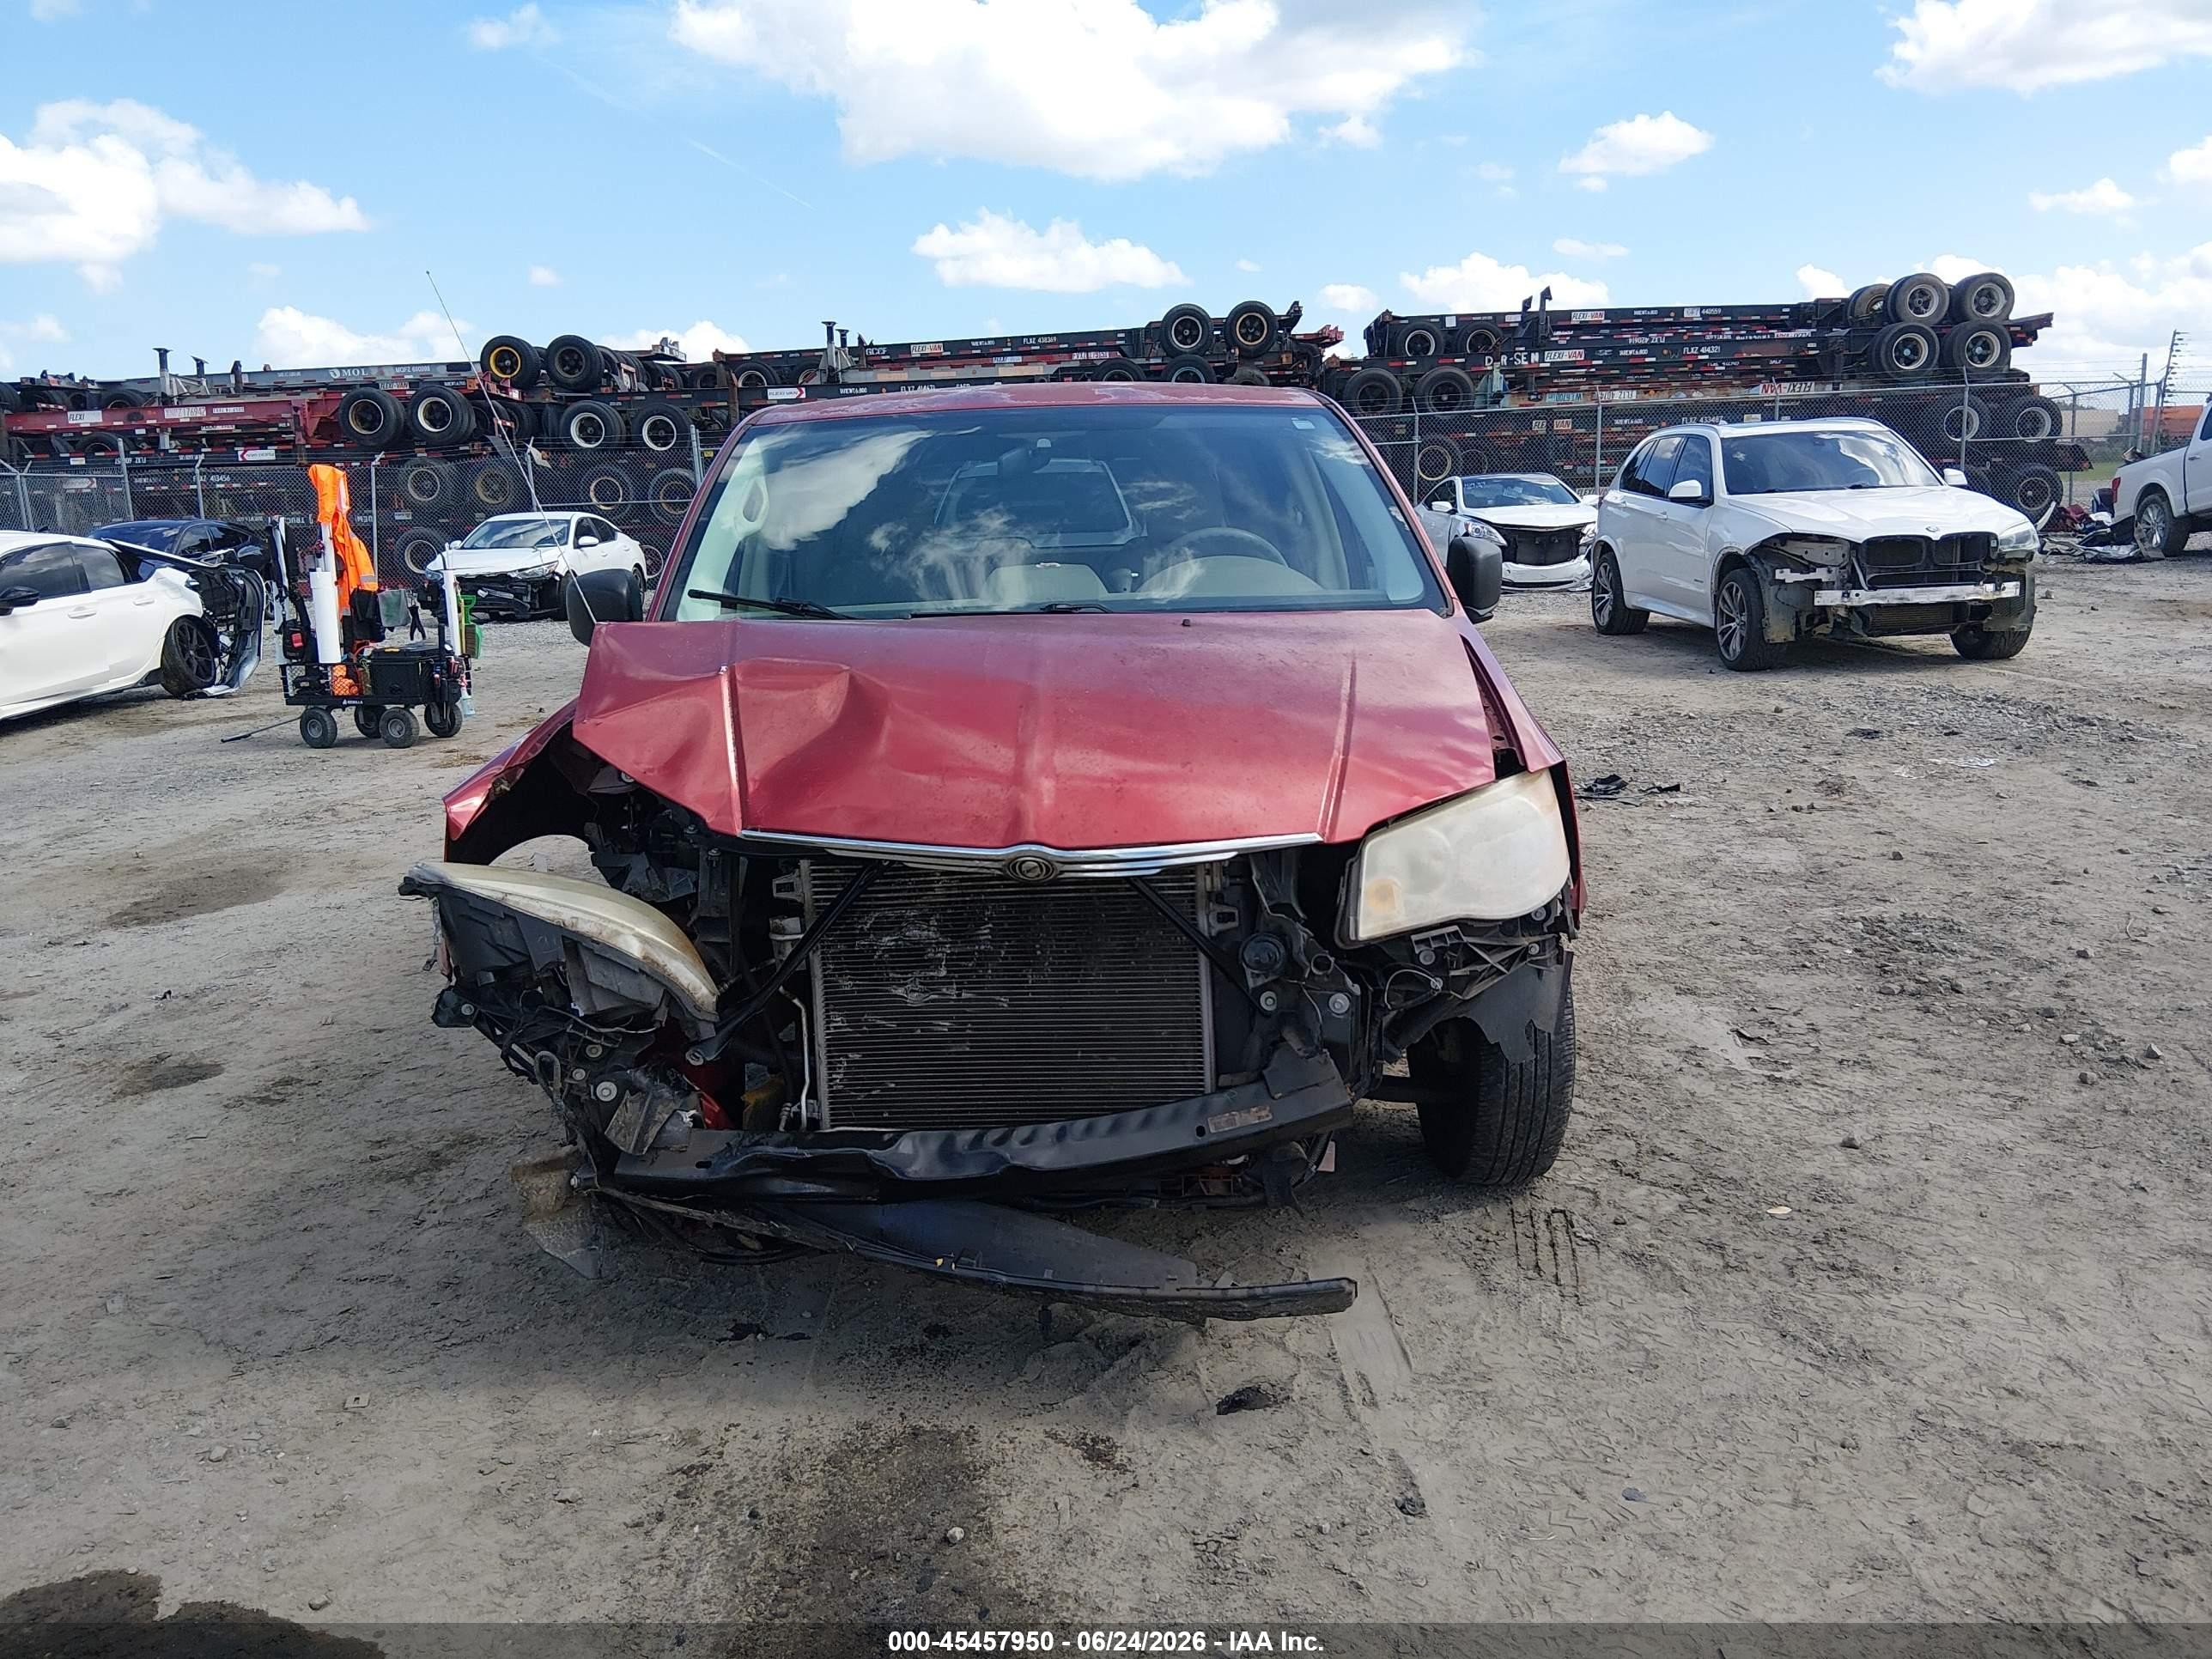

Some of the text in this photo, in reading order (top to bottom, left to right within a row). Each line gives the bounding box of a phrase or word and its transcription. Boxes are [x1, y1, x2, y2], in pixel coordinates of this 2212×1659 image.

[1572, 312, 1603, 320] FLEXI-VAN
[911, 343, 942, 353] FLEXI-VAN
[1546, 350, 1583, 360] FLEXI-VAN
[1761, 382, 1812, 396] FLEXI-VAN
